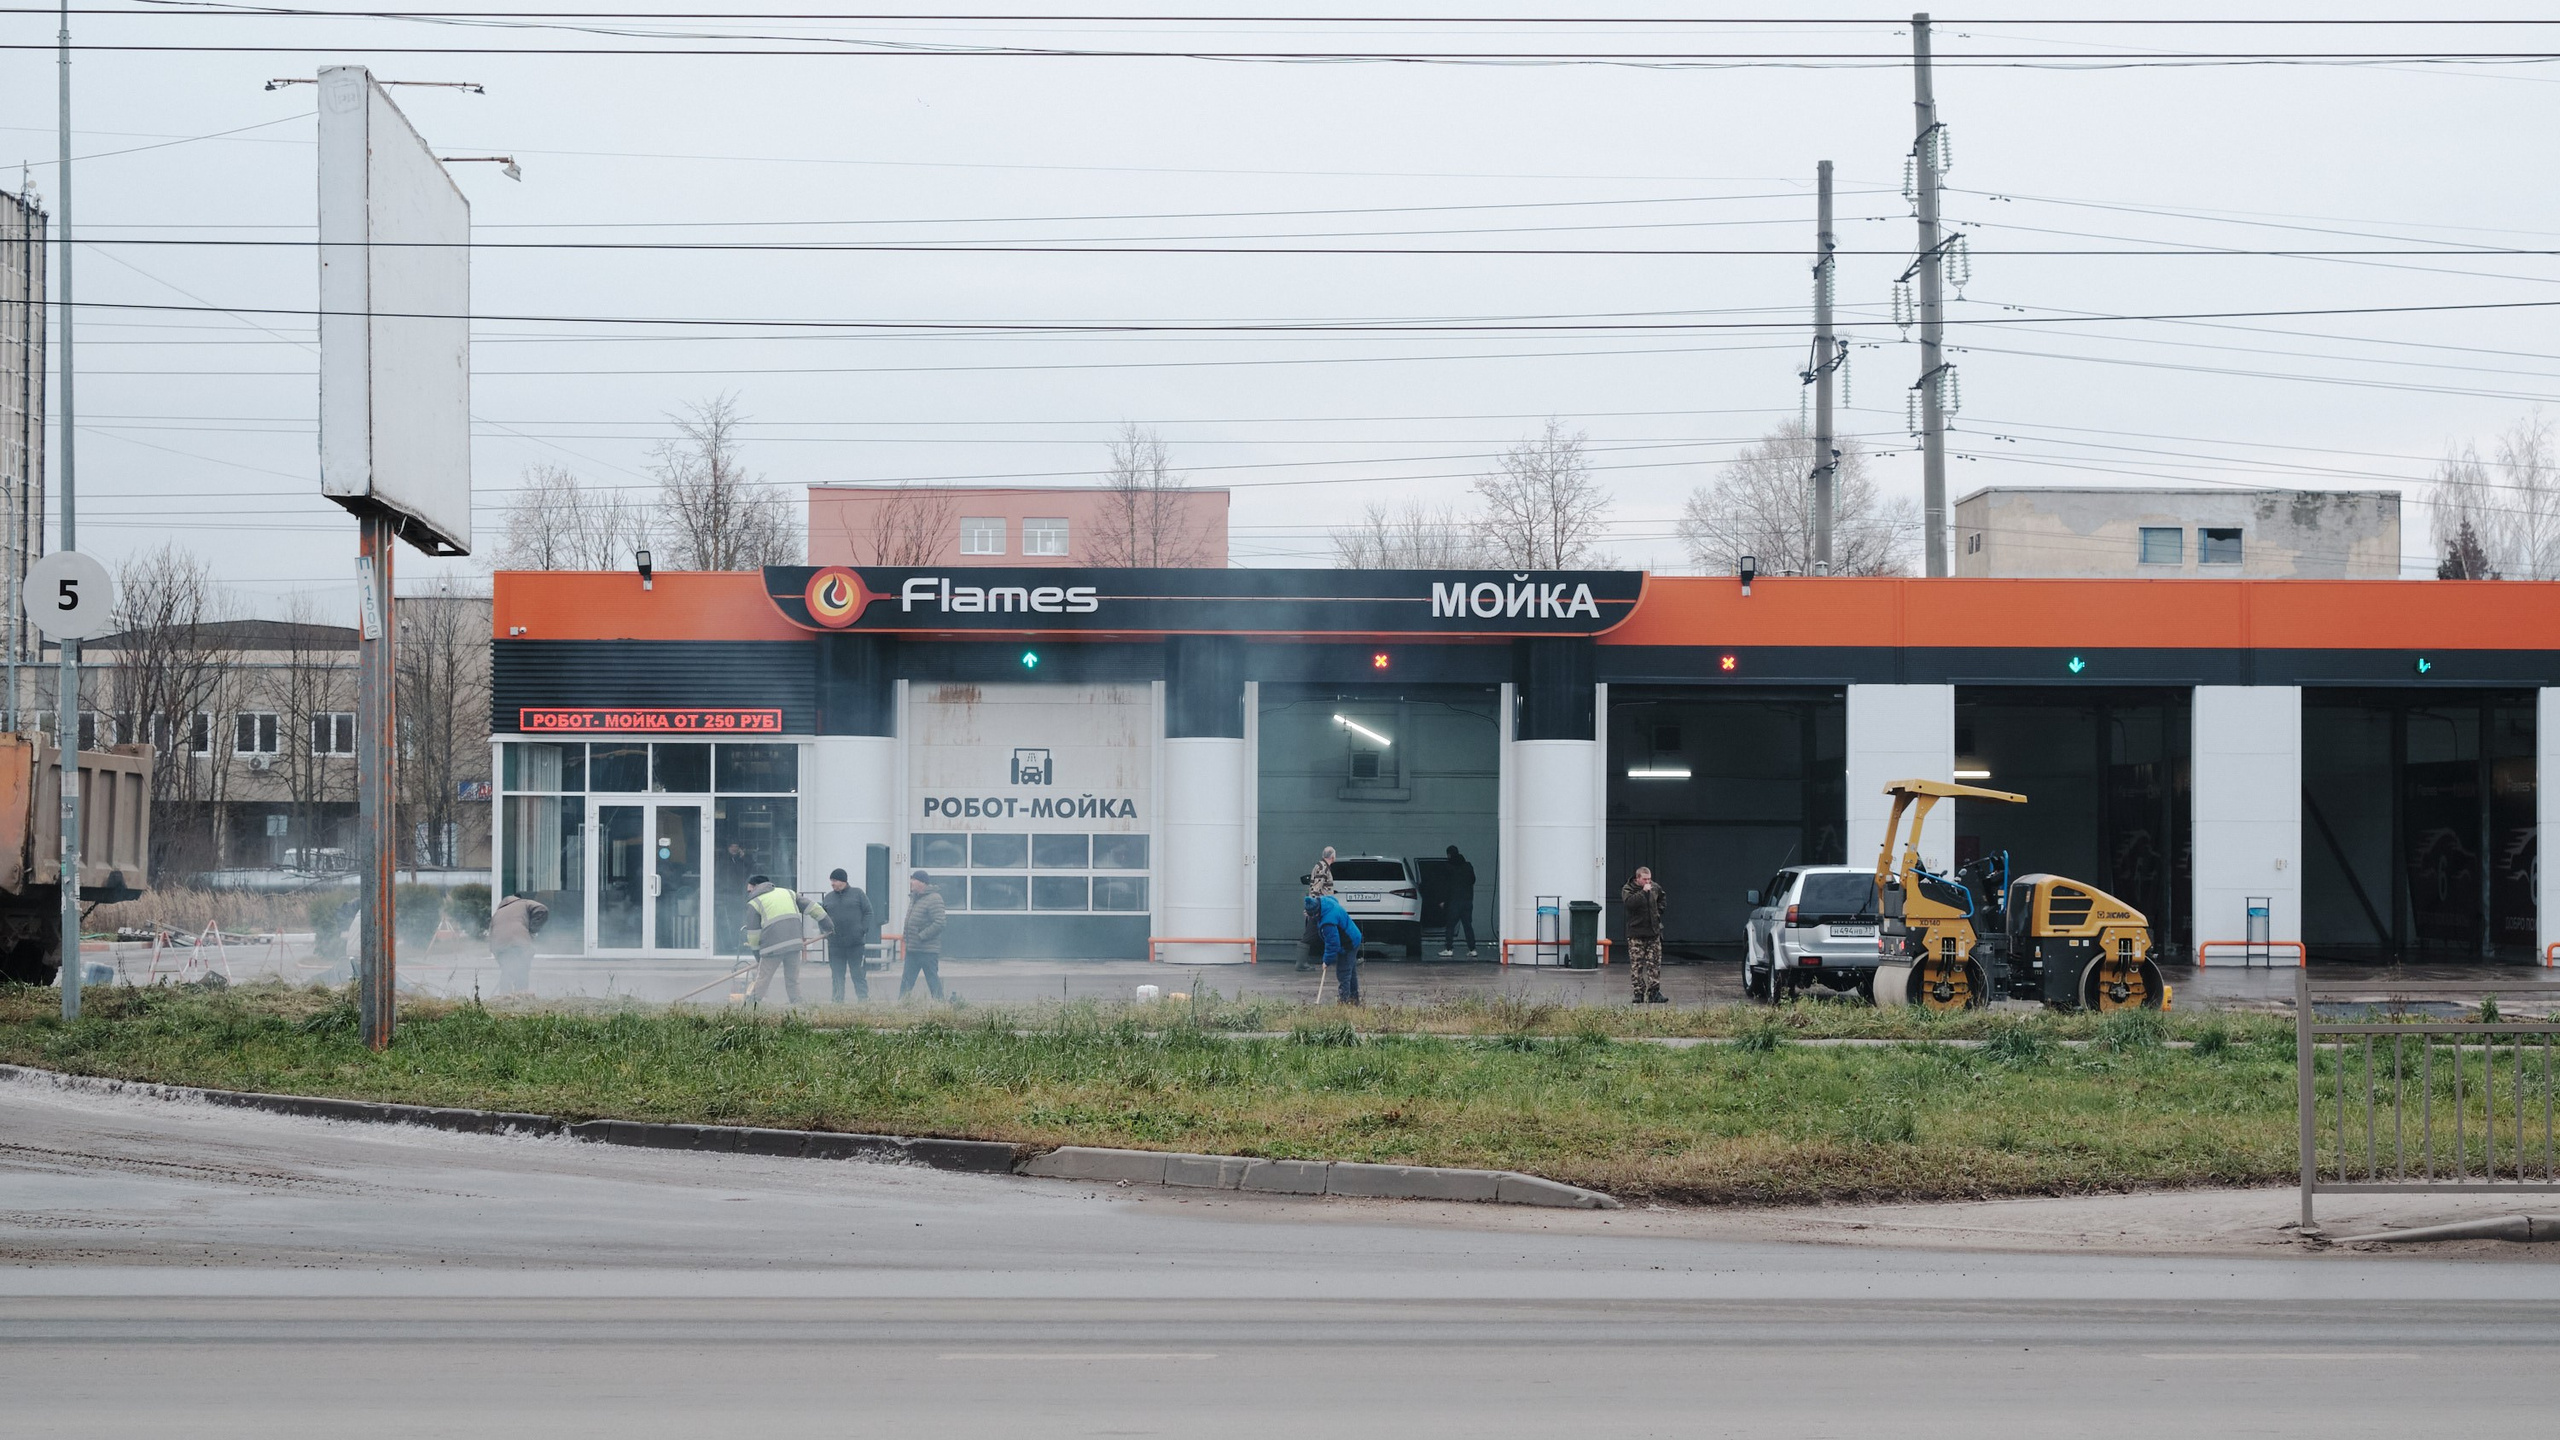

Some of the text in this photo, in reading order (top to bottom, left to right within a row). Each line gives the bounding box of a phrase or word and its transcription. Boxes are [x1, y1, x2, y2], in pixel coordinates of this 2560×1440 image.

[58, 579, 79, 611] 5
[902, 577, 1099, 613] Flames
[1432, 573, 1600, 619] МОЙКА
[533, 711, 775, 728] РОБОТ- МОЙКА ОТ 250 РУБ
[924, 793, 1138, 819] РОБОТ-МОЙКА
[2106, 911, 2131, 919] XCMG
